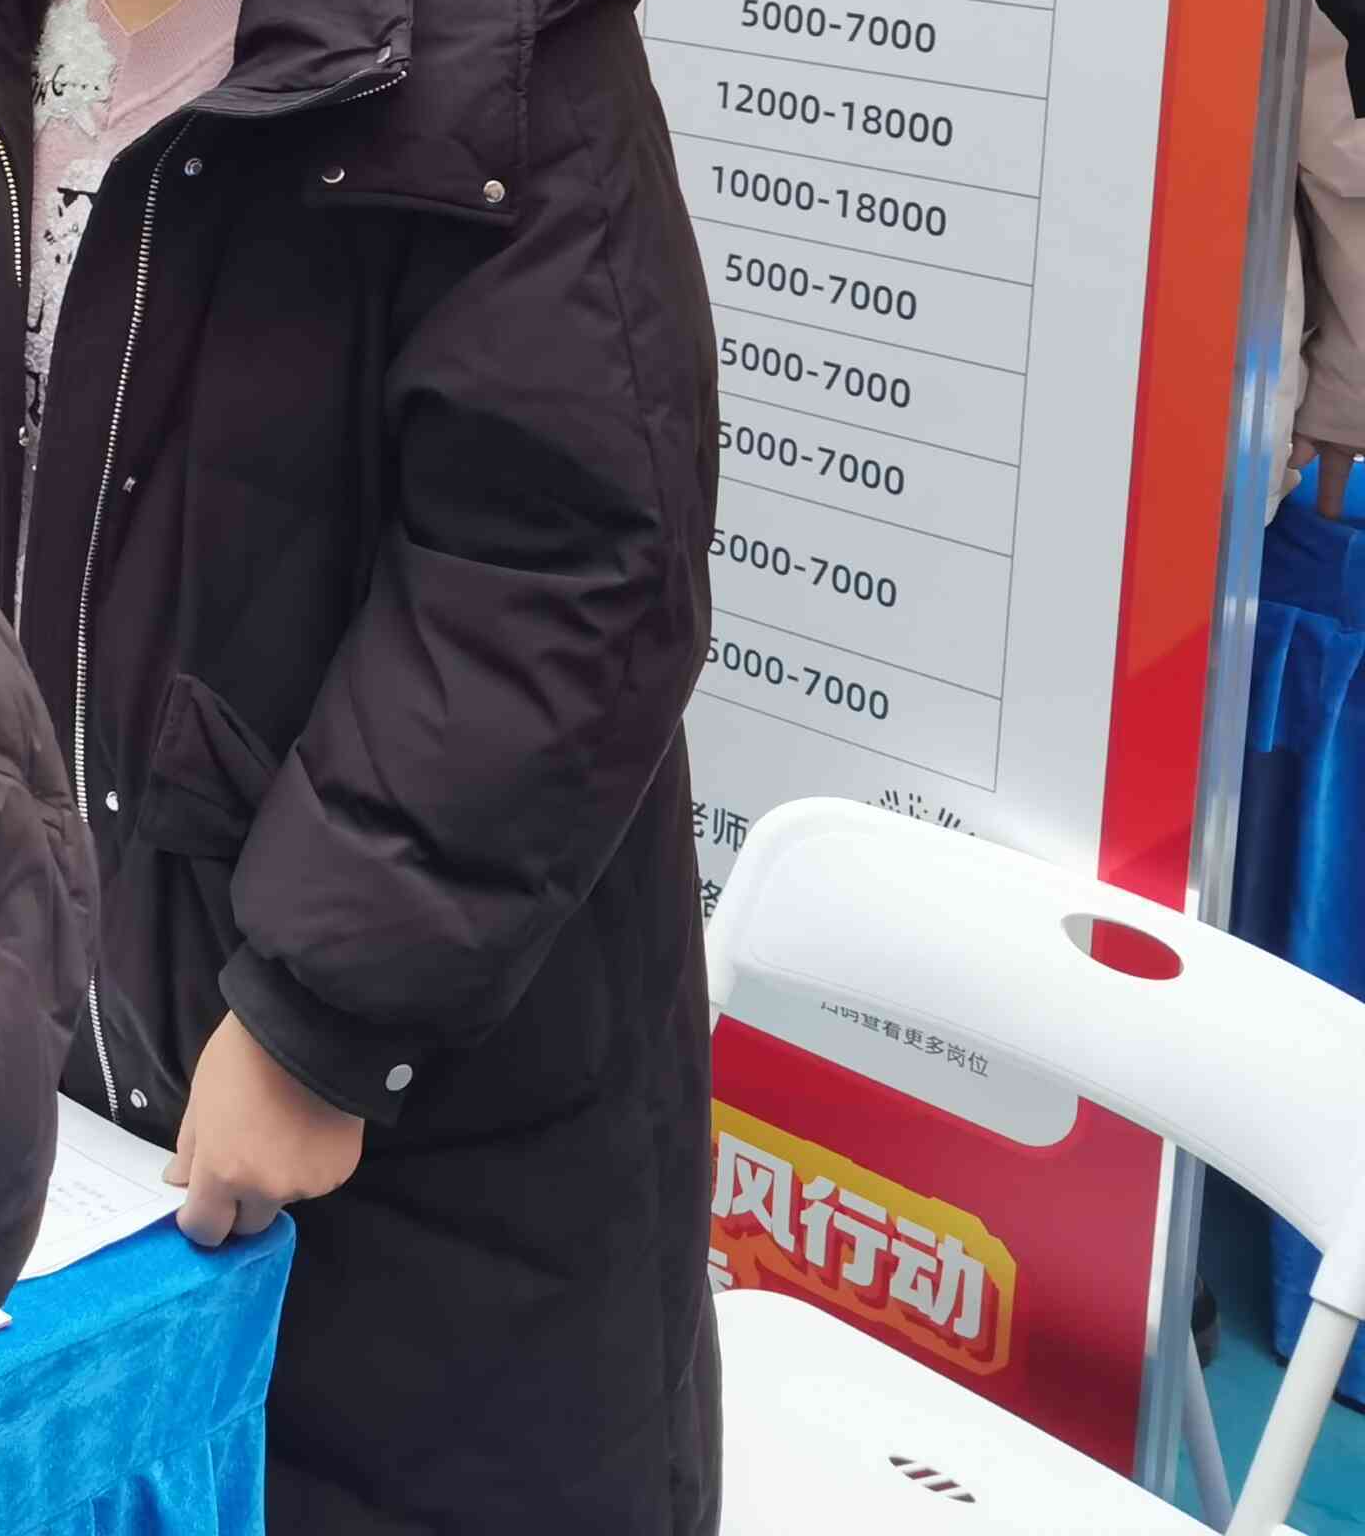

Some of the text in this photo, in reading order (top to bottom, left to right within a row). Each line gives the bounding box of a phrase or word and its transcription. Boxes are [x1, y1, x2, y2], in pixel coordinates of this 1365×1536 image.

[715, 80, 955, 148] 12000-18000
[710, 164, 947, 237] 10000-18000
[725, 253, 918, 321] 5000-7000
[719, 337, 911, 409] 5000-7000
[716, 421, 905, 496] 5000-7000
[707, 529, 898, 608] 5000-7000
[711, 1130, 985, 1340] 风行动
